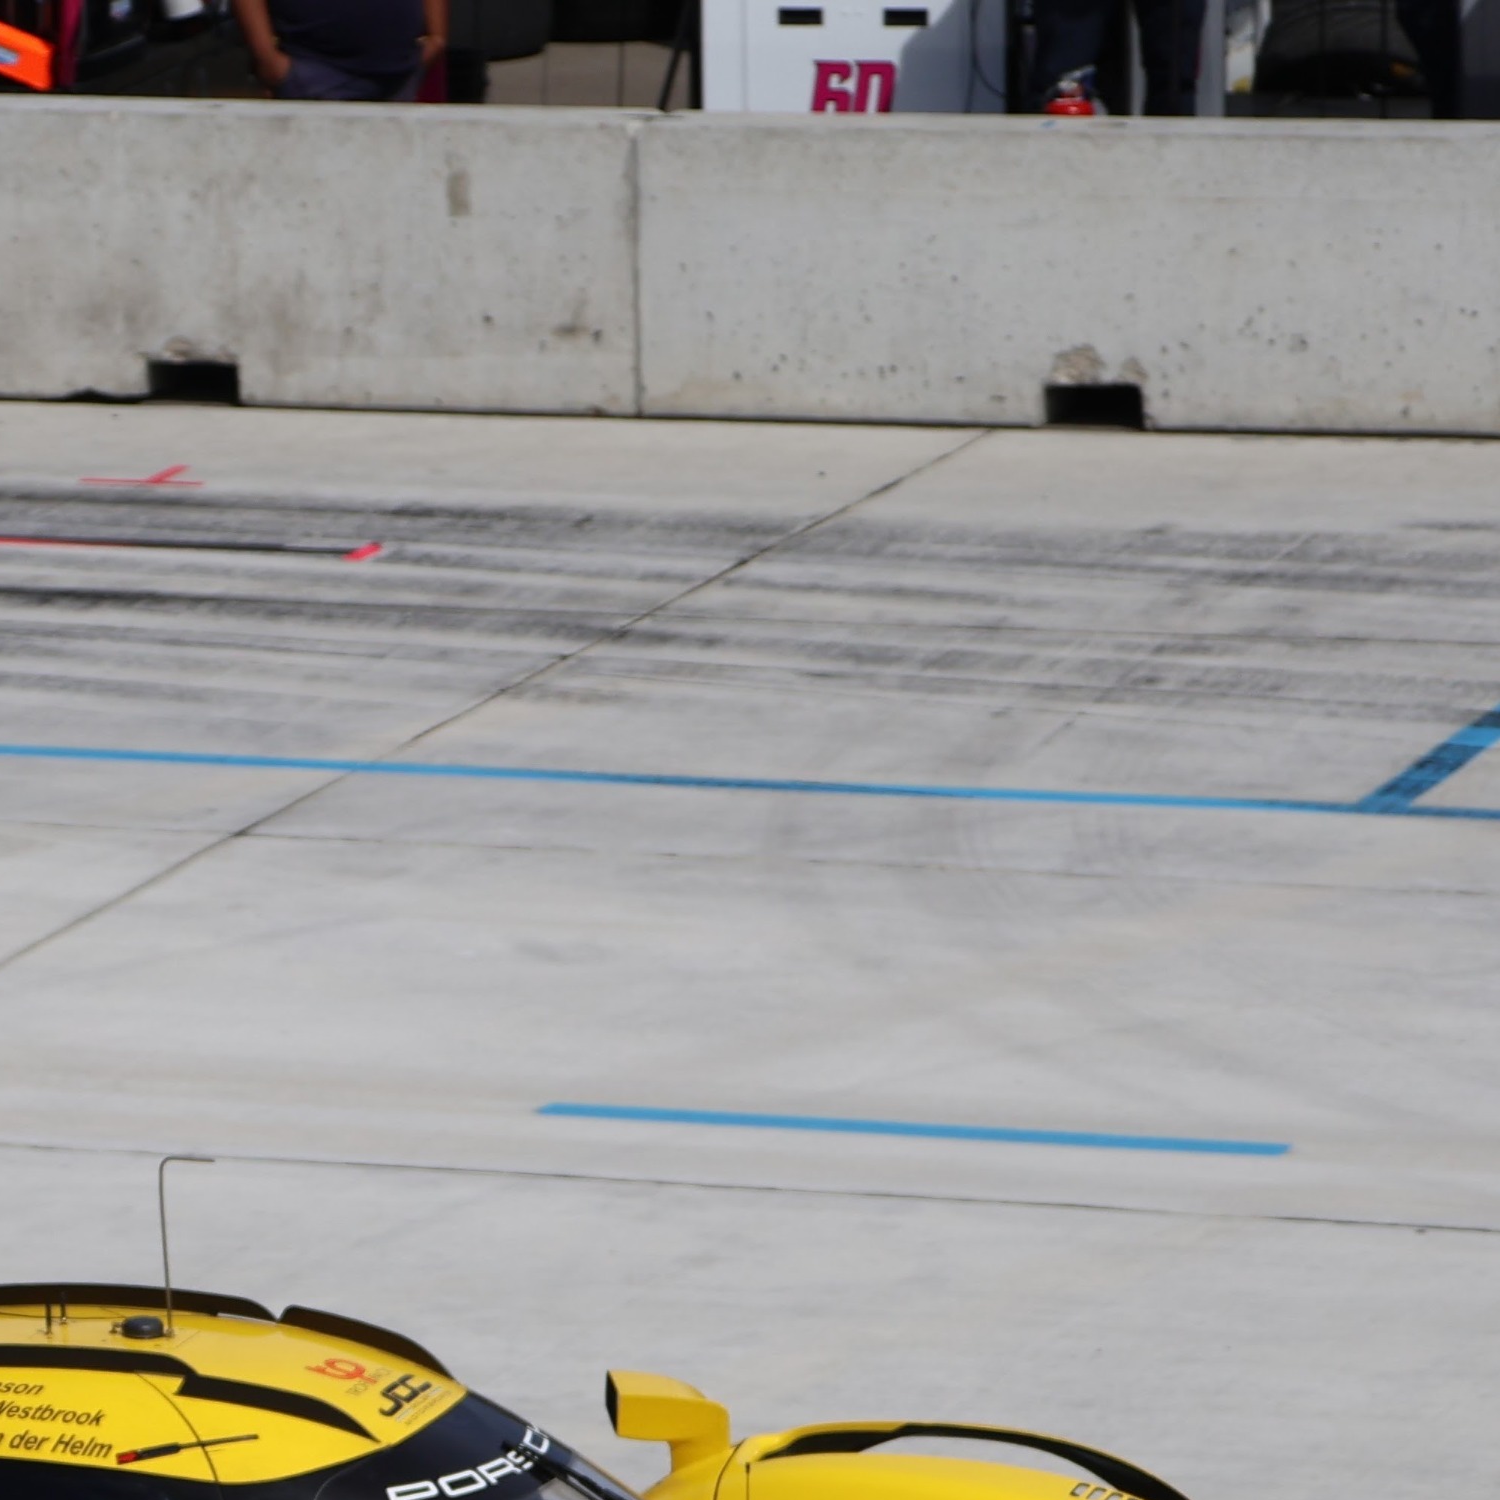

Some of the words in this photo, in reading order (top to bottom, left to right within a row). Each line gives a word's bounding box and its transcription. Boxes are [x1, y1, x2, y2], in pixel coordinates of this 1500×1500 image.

[812, 60, 898, 112] 60
[9, 1430, 50, 1450] der
[51, 1434, 113, 1459] Helm
